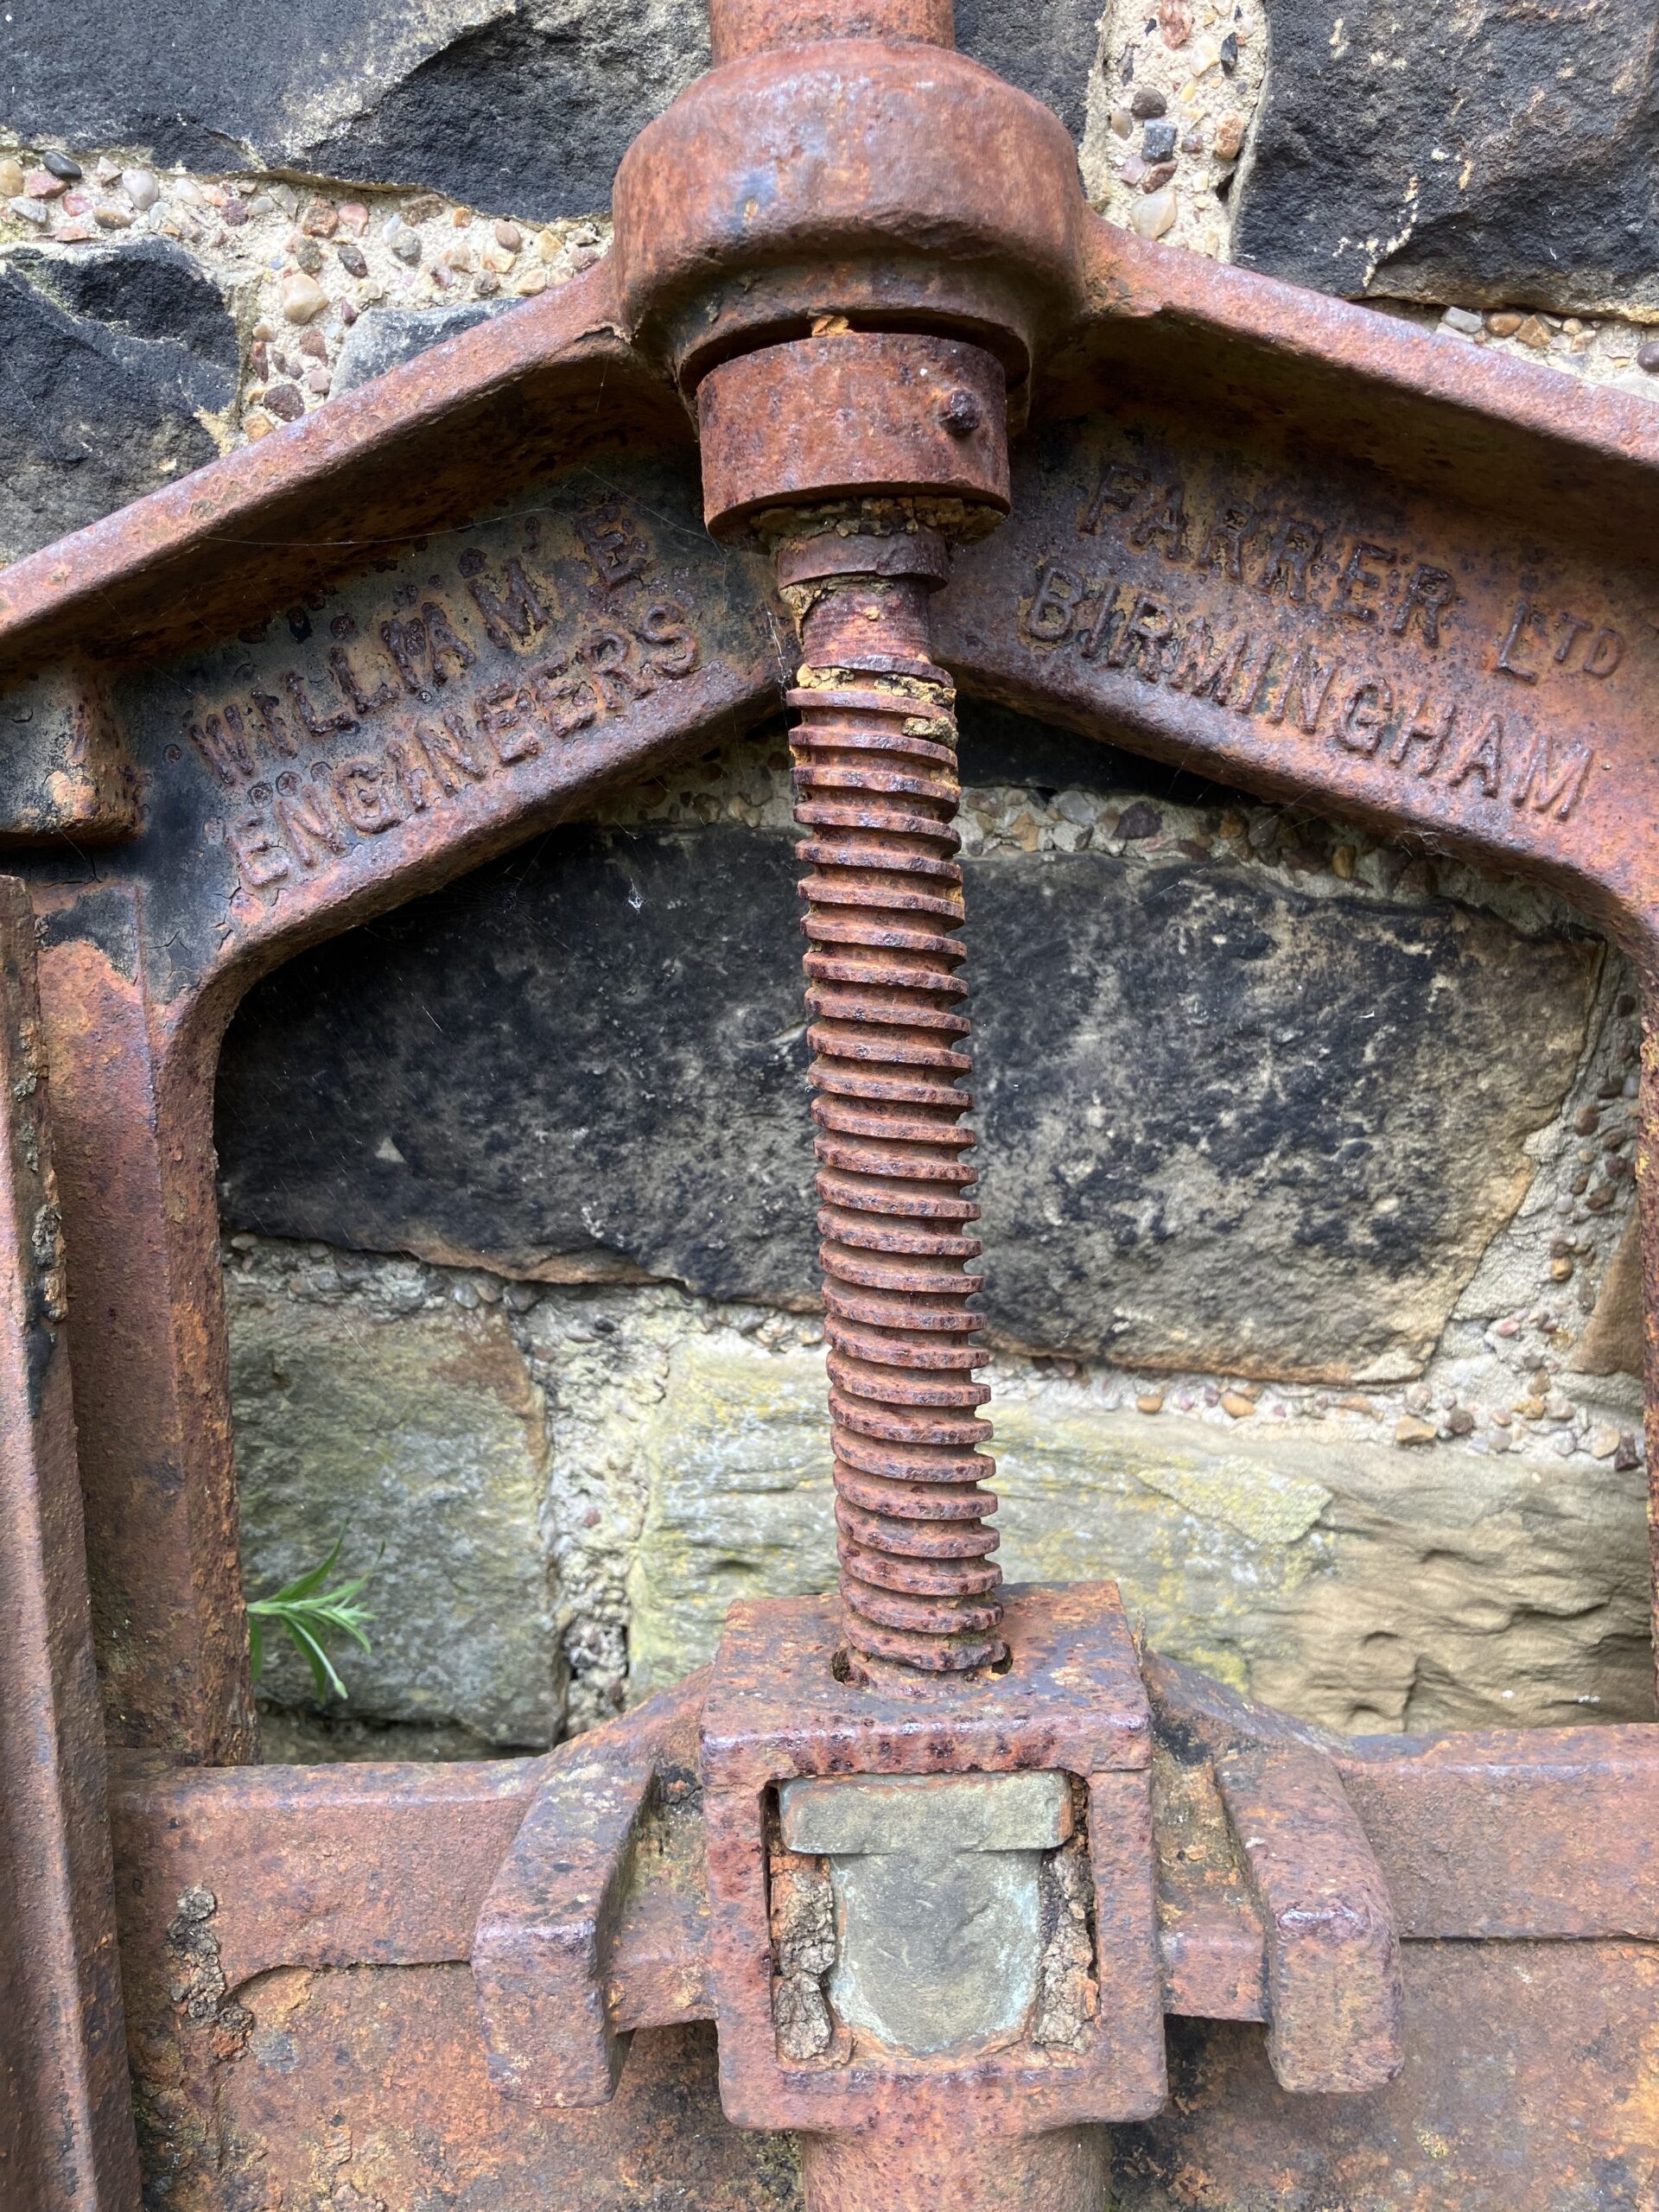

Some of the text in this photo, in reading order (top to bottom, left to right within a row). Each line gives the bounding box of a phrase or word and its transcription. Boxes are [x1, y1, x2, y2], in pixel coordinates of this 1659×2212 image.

[1077, 462, 1457, 650] FARRER
[226, 605, 698, 887] ENGINEERS
[1025, 564, 1596, 823] BIRMINGHAM
